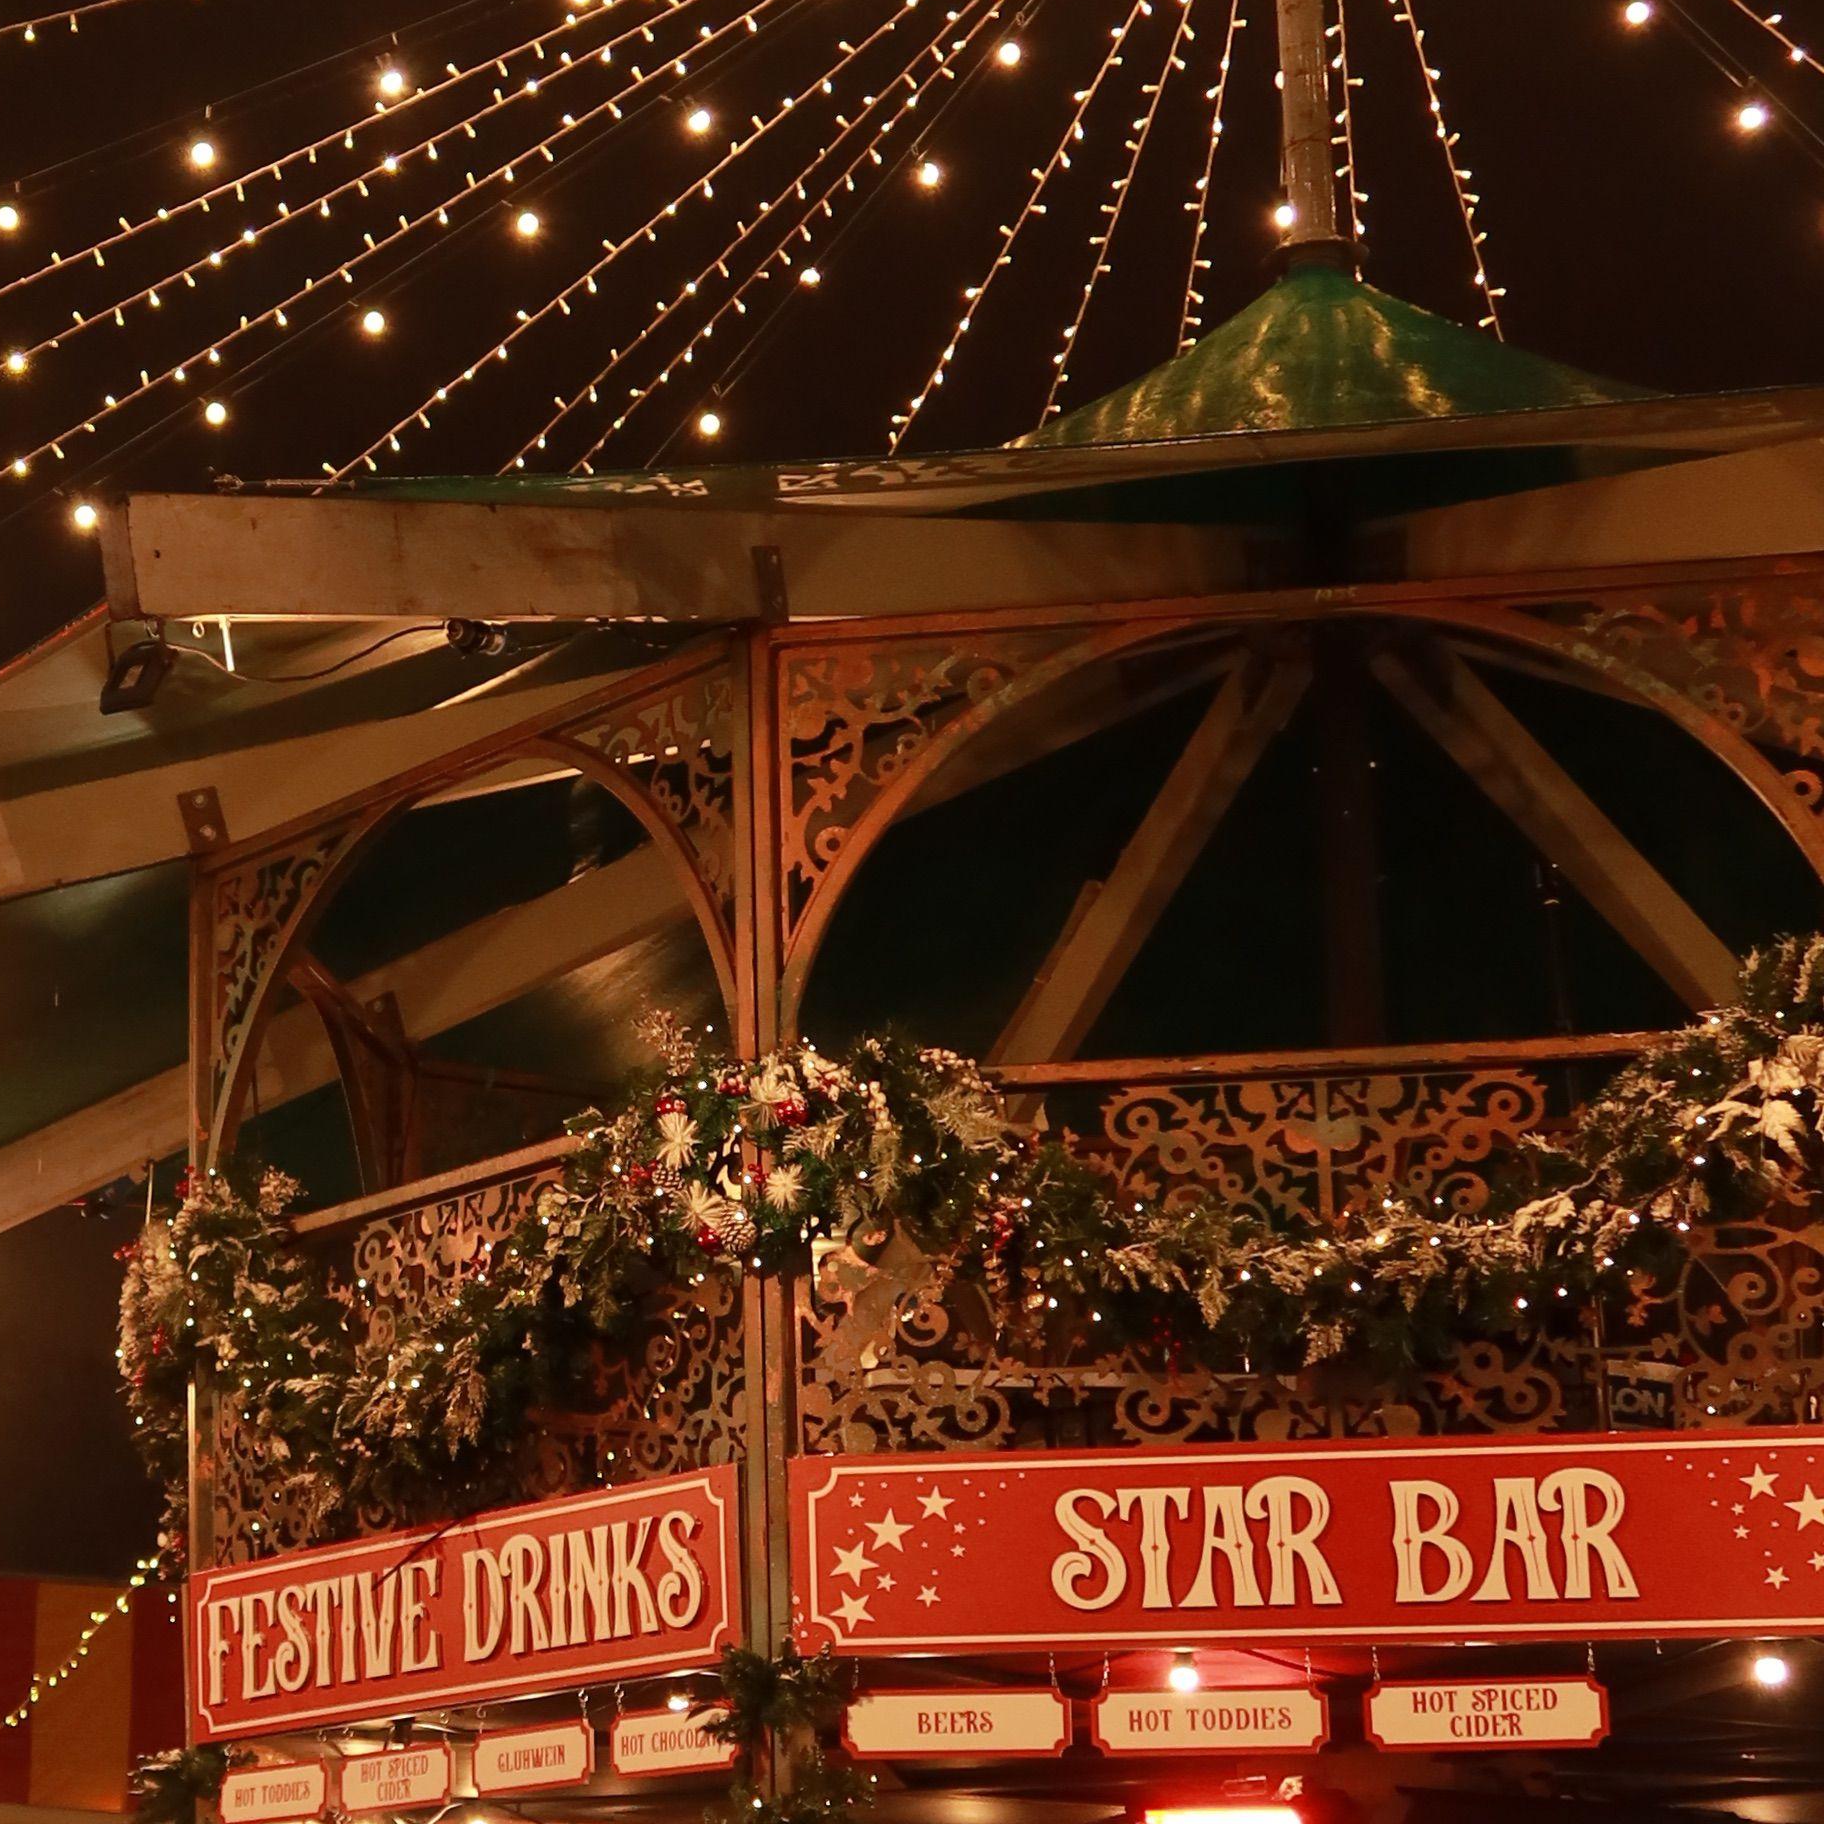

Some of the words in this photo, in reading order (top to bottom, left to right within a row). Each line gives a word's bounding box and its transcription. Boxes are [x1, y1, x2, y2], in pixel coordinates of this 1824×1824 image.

[1051, 1475, 1343, 1610] STAR
[1389, 1467, 1641, 1604] BAR
[206, 1558, 440, 1706] FESTIVE
[461, 1509, 703, 1663] DRINKS
[1412, 1690, 1458, 1714] HOT
[1472, 1687, 1558, 1713] SPICED
[917, 1710, 995, 1736] BEERS
[1128, 1709, 1174, 1733] HOT
[1186, 1706, 1293, 1732] TODDIES
[1449, 1713, 1523, 1738] CIDER
[619, 1738, 646, 1758] HOT
[360, 1761, 383, 1784] HOT
[387, 1754, 429, 1779] SPICED
[235, 1786, 256, 1809] HOT
[261, 1780, 311, 1804] TODDIES
[378, 1778, 412, 1803] CIDER
